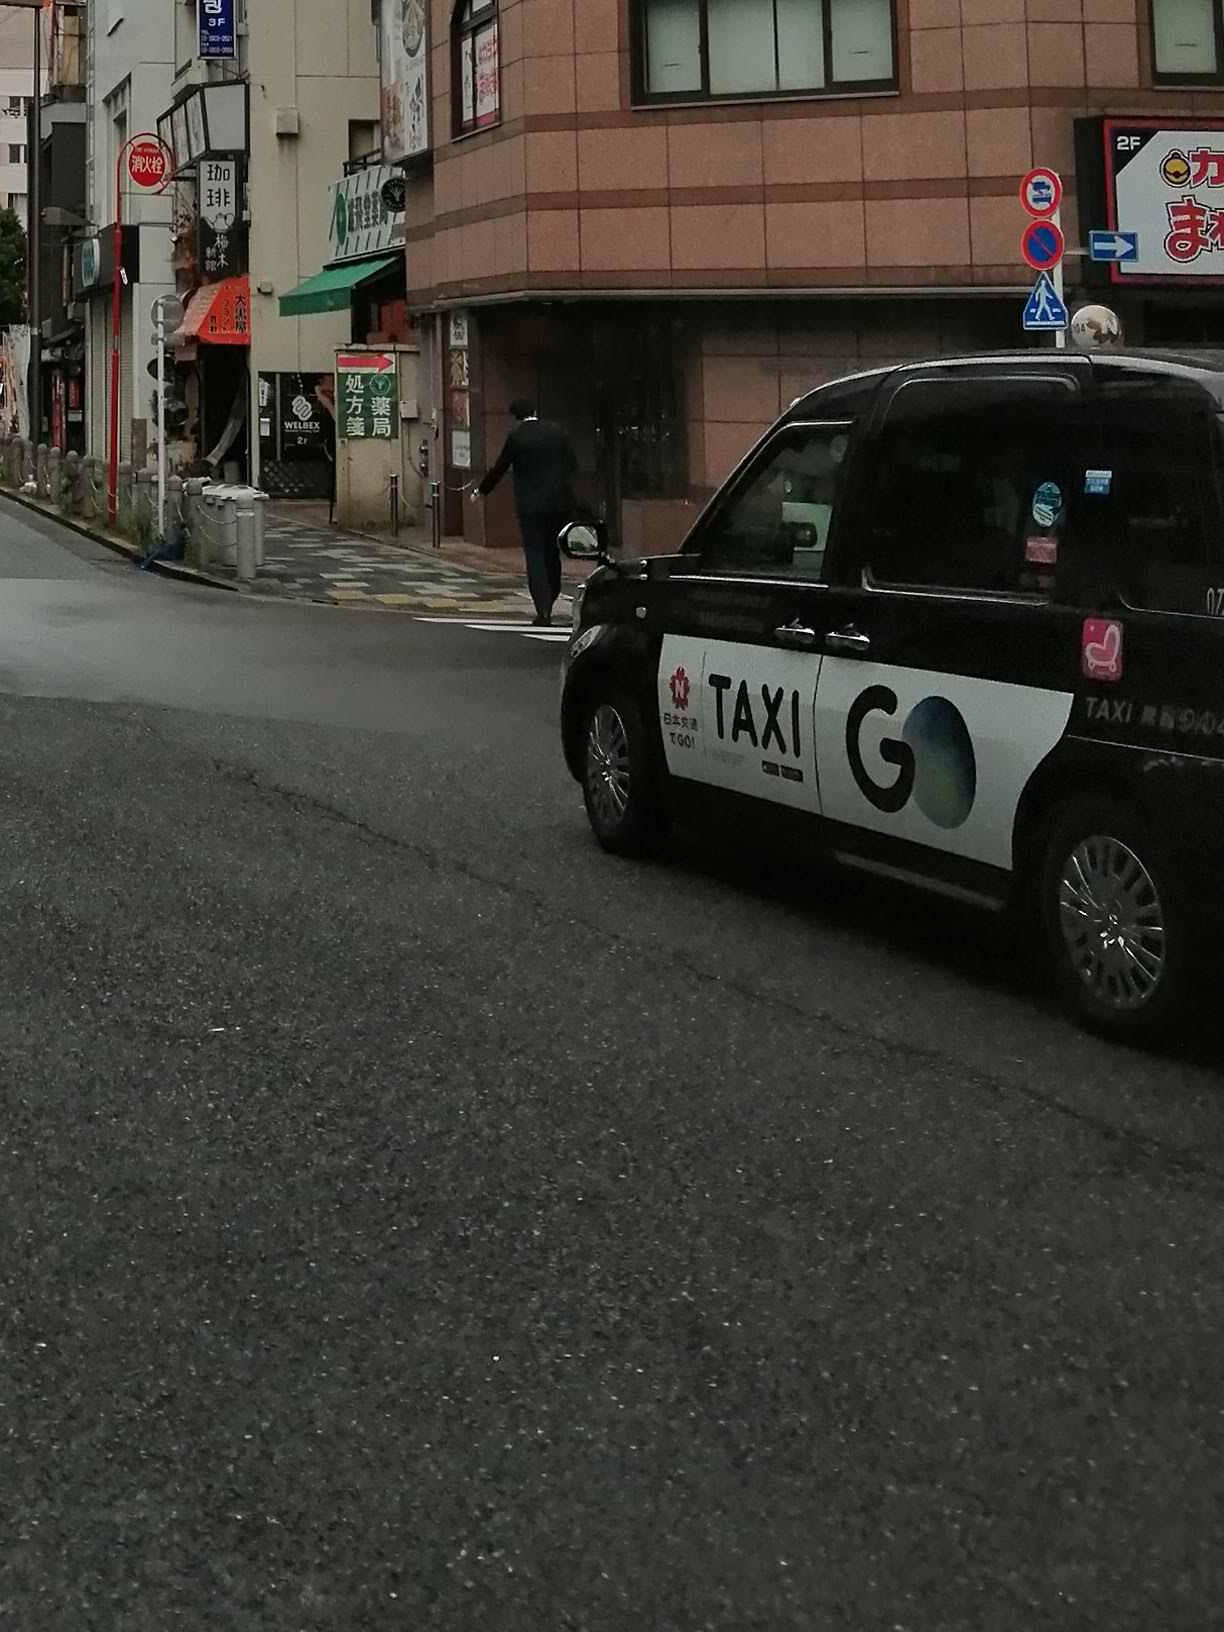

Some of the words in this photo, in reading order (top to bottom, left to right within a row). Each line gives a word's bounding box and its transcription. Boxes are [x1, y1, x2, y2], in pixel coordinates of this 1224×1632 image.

[208, 18, 226, 27] 3F
[1116, 136, 1141, 151] 2F
[132, 155, 163, 174] 消火栓
[207, 164, 231, 207] 珈琲
[235, 293, 247, 334] 大黒屋
[345, 374, 365, 437] 処方箋
[370, 396, 391, 437] 薬局
[284, 421, 320, 430] WELBEX
[708, 673, 801, 758] TAXI
[1086, 697, 1133, 723] TAXI
